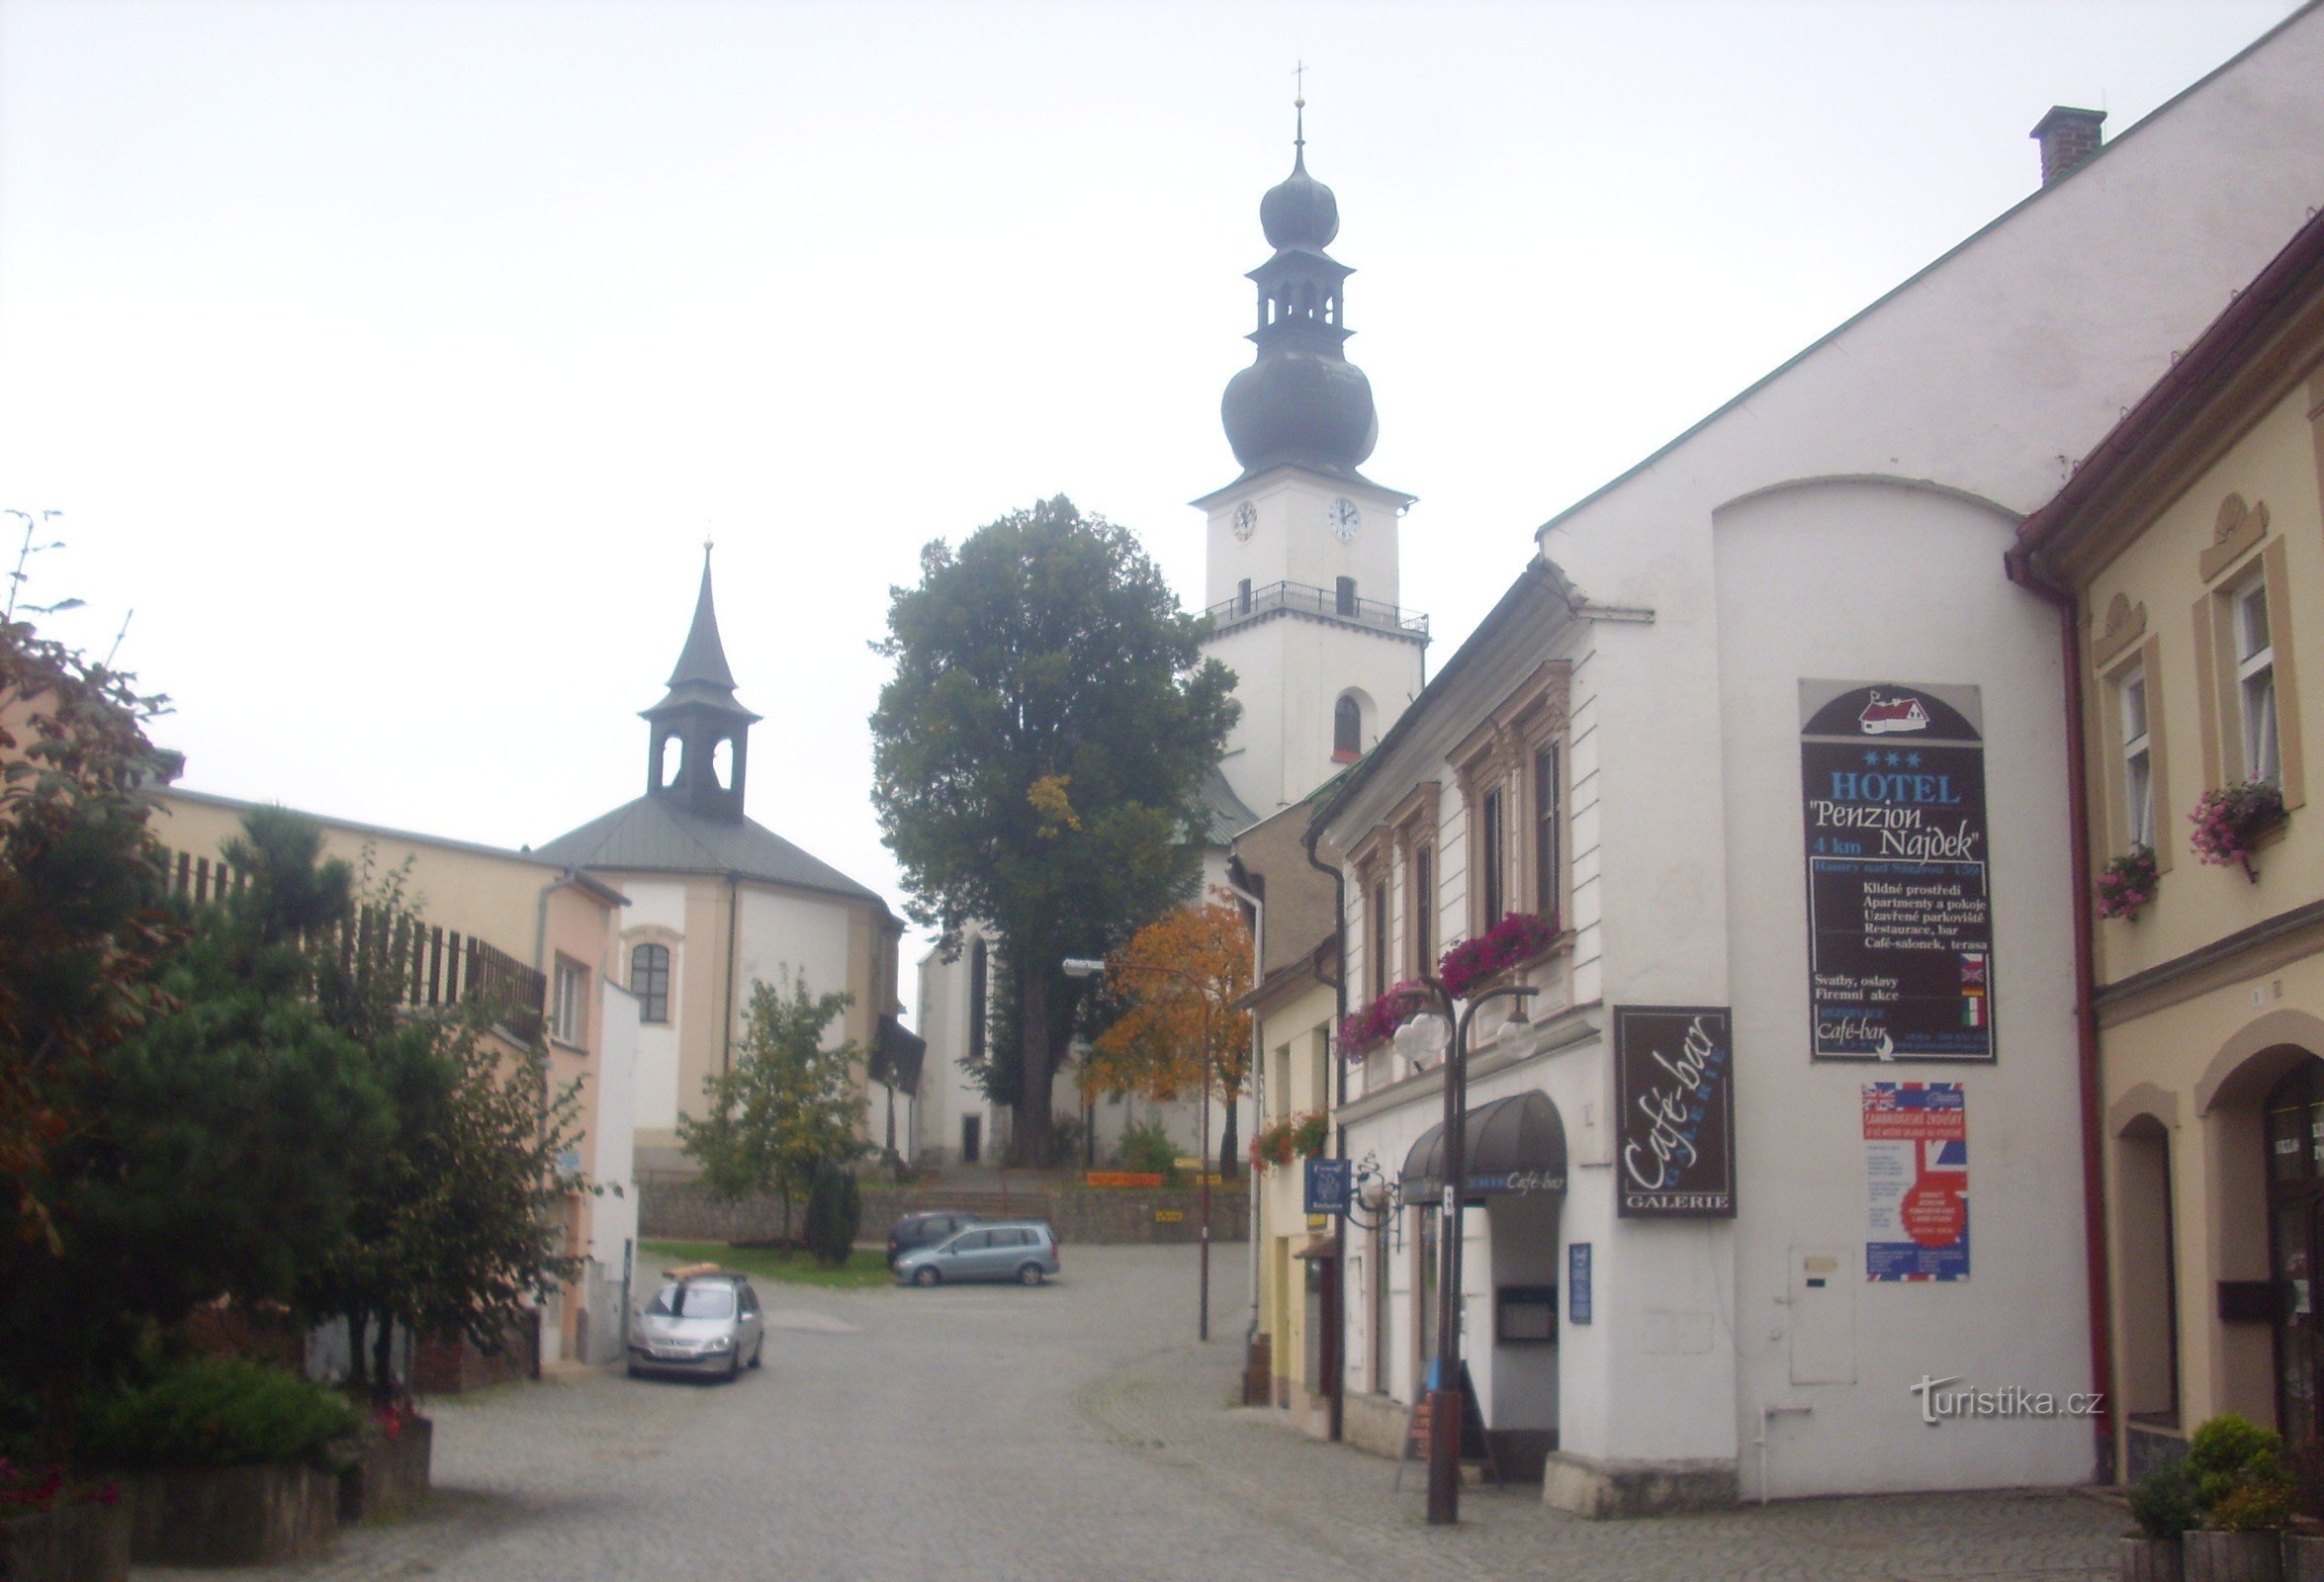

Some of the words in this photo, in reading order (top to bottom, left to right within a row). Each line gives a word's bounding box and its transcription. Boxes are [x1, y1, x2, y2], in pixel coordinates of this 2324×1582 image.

[1832, 771, 1961, 804] HOTEL
[1810, 799, 1922, 829] "Penzion
[1815, 837, 1826, 854] 4
[1832, 838, 1861, 854] km
[1863, 882, 1903, 894] Klidné
[1907, 883, 1961, 896] prostředí
[1863, 896, 1933, 910] Apartmenty
[1947, 899, 1986, 911] pokoje
[1864, 910, 1920, 922] Uzavřené
[1922, 911, 1985, 923] parkoviště
[1864, 923, 1935, 935] Restaurace,
[1938, 924, 1959, 935] bar
[1864, 936, 1945, 950] Café-salonek,
[1951, 939, 1987, 950] terasa
[1815, 974, 1857, 988] Svatby,
[1860, 976, 1898, 989] oslavy
[1815, 989, 1863, 1001] Firemní
[1870, 990, 1899, 1001] akce
[1818, 1016, 1886, 1044] Café-bar
[1625, 1016, 1714, 1189] Café-bar
[1626, 1195, 1730, 1209] GALERIE
